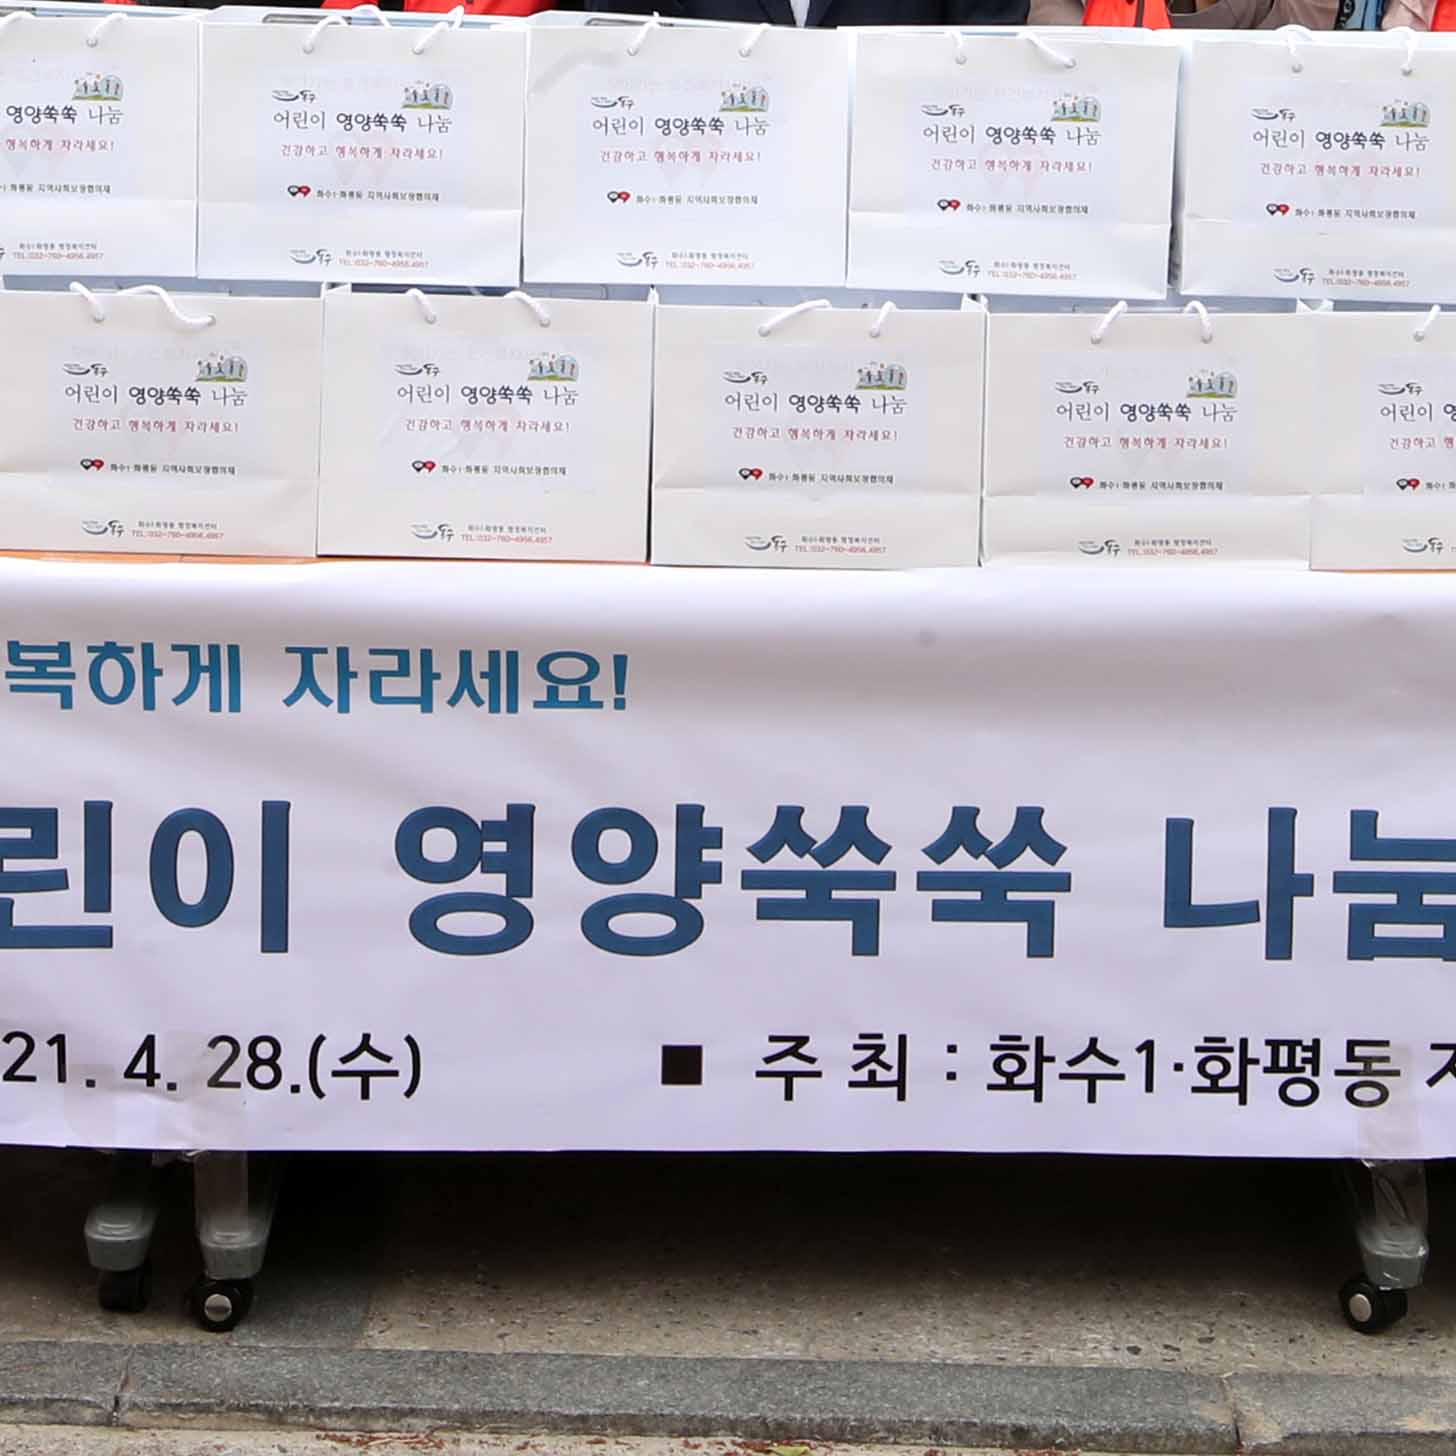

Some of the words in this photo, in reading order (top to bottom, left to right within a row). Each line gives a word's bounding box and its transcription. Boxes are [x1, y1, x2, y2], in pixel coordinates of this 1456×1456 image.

[6, 105, 77, 124] 영양쑥쑥
[89, 106, 123, 125] 나눔
[274, 111, 325, 131] 어린이
[337, 112, 407, 132] 영양쑥쑥
[418, 114, 452, 133] 나눔
[593, 117, 644, 137] 어린이
[655, 117, 724, 137] 영양쑥쑥
[736, 117, 770, 136] 나눔
[924, 126, 975, 144] 어린이
[986, 126, 1056, 145] 영양쑥쑥
[1067, 127, 1101, 146] 나눔
[61, 139, 114, 151] 자라세요!
[1254, 130, 1305, 149] 어린이
[1315, 131, 1385, 150] 영양쑥쑥
[1396, 132, 1430, 151] 나눔
[282, 145, 328, 156] 건강하고
[390, 147, 443, 159] 자라세요!
[602, 151, 647, 162] 건강하고
[709, 150, 761, 163] 자라세요!
[932, 159, 978, 170] 건강하고
[1040, 160, 1092, 172] 자라세요!
[1262, 164, 1307, 175] 건강하고
[1368, 165, 1421, 177] 자라세요!
[65, 385, 118, 404] 어린이
[129, 386, 201, 405] 영양쑥쑥
[213, 387, 248, 406] 나눔
[398, 385, 450, 405] 어린이
[461, 386, 533, 405] 영양쑥쑥
[544, 386, 579, 406] 나눔
[725, 393, 778, 413] 어린이
[789, 394, 861, 414] 영양쑥쑥
[872, 395, 907, 415] 나눔
[1057, 403, 1109, 422] 어린이
[1120, 403, 1191, 422] 영양쑥쑥
[1203, 403, 1237, 422] 나눔
[1381, 403, 1433, 424] 어린이
[74, 419, 121, 430] 건강하고
[185, 421, 239, 432] 자라세요!
[407, 419, 453, 431] 건강하고
[516, 420, 570, 432] 자라세요!
[734, 427, 781, 439] 건강하고
[844, 429, 898, 441] 자라세요!
[1065, 437, 1112, 448] 건강하고
[1174, 437, 1228, 449] 자라세요!
[1390, 437, 1436, 450] 건강하고
[285, 646, 628, 714] 자라세요!
[394, 803, 1072, 959] 영양쑥쑥
[119, 1034, 183, 1099] 4.
[200, 1032, 421, 1101] 28.(수)
